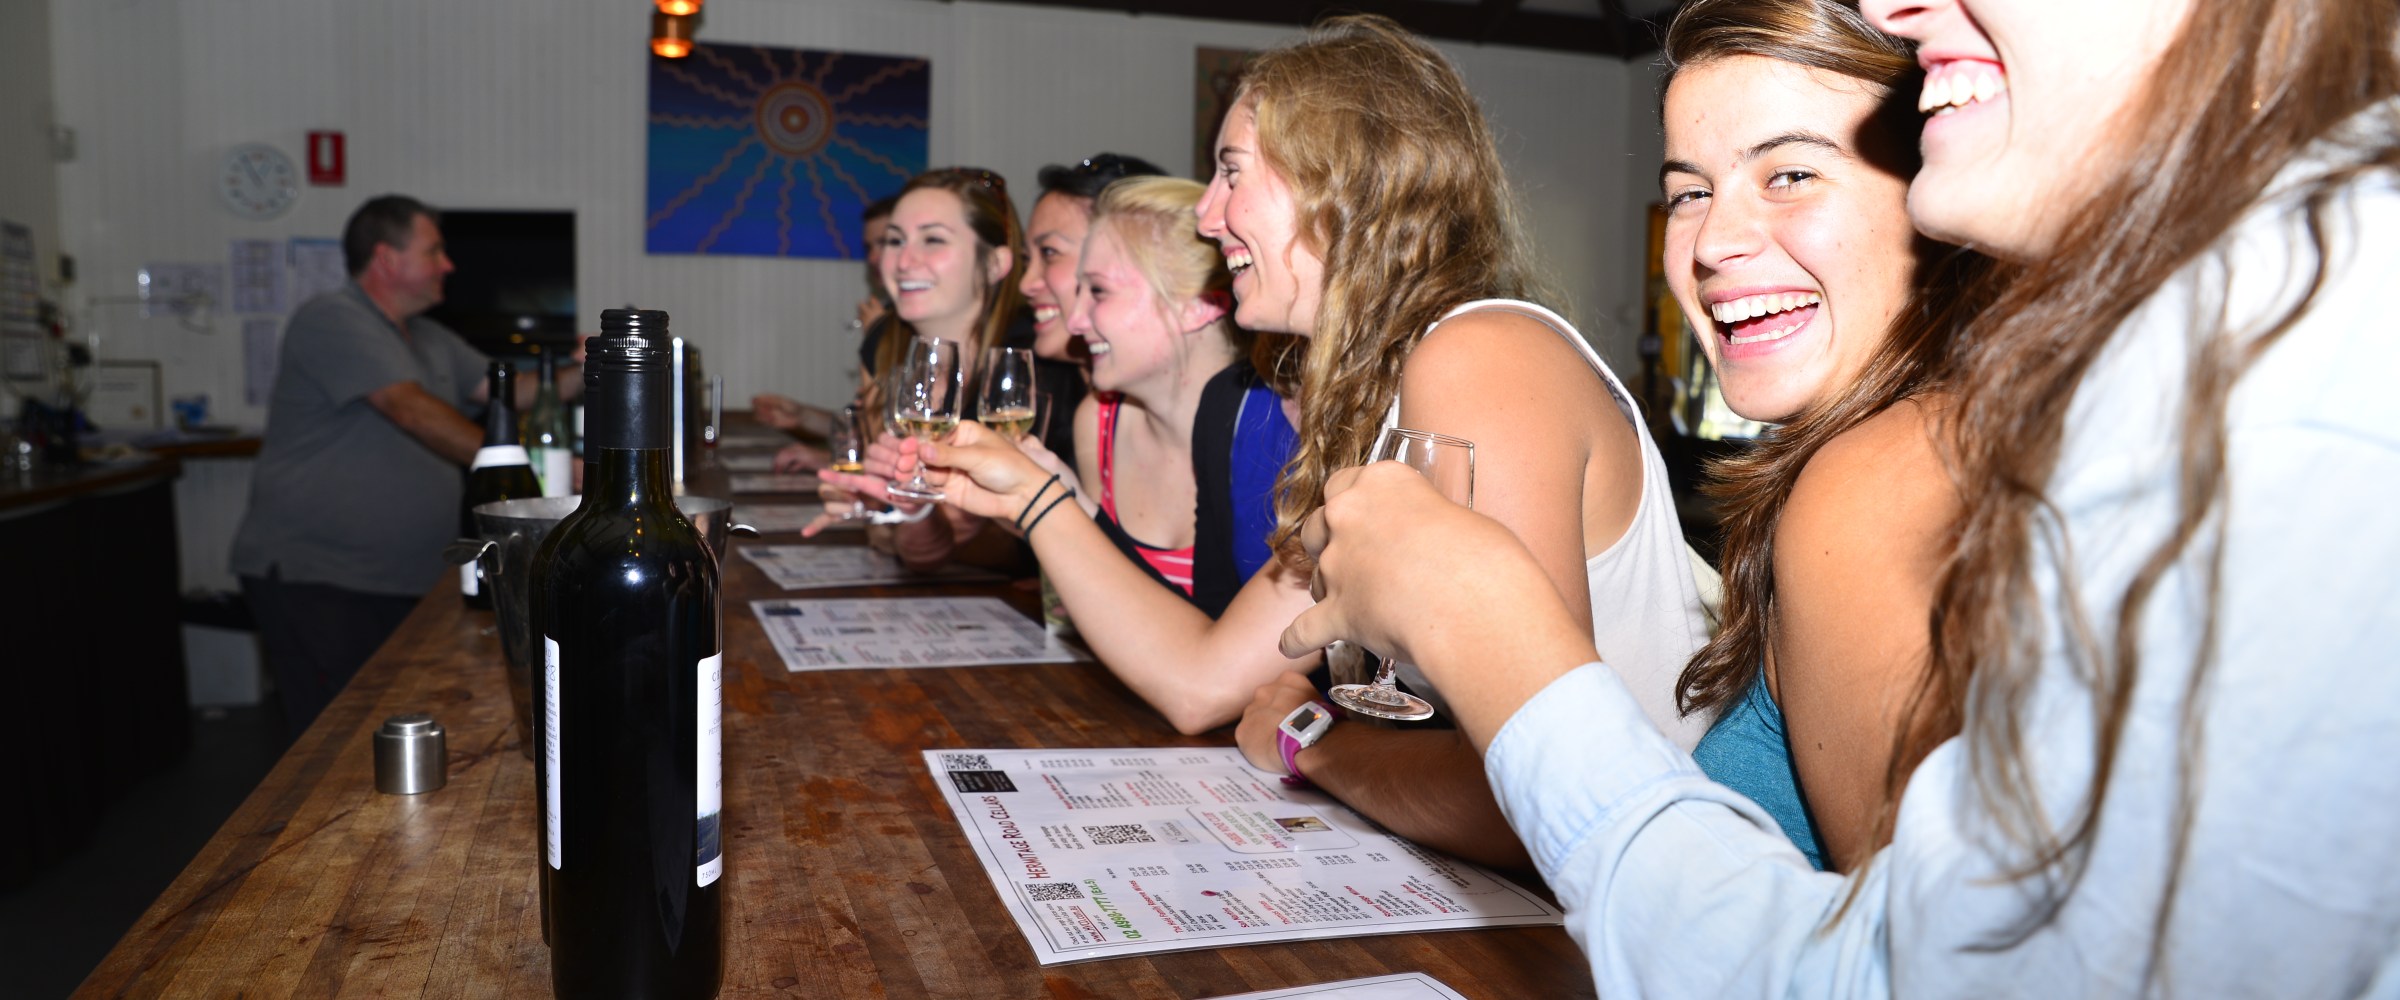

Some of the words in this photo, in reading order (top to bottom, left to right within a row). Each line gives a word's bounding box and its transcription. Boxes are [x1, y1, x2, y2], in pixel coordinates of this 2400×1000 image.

[982, 796, 1009, 819] CELLARS
[999, 821, 1022, 839] ROAD
[1010, 841, 1049, 878] HERMITAGE
[1122, 930, 1141, 939] 02
